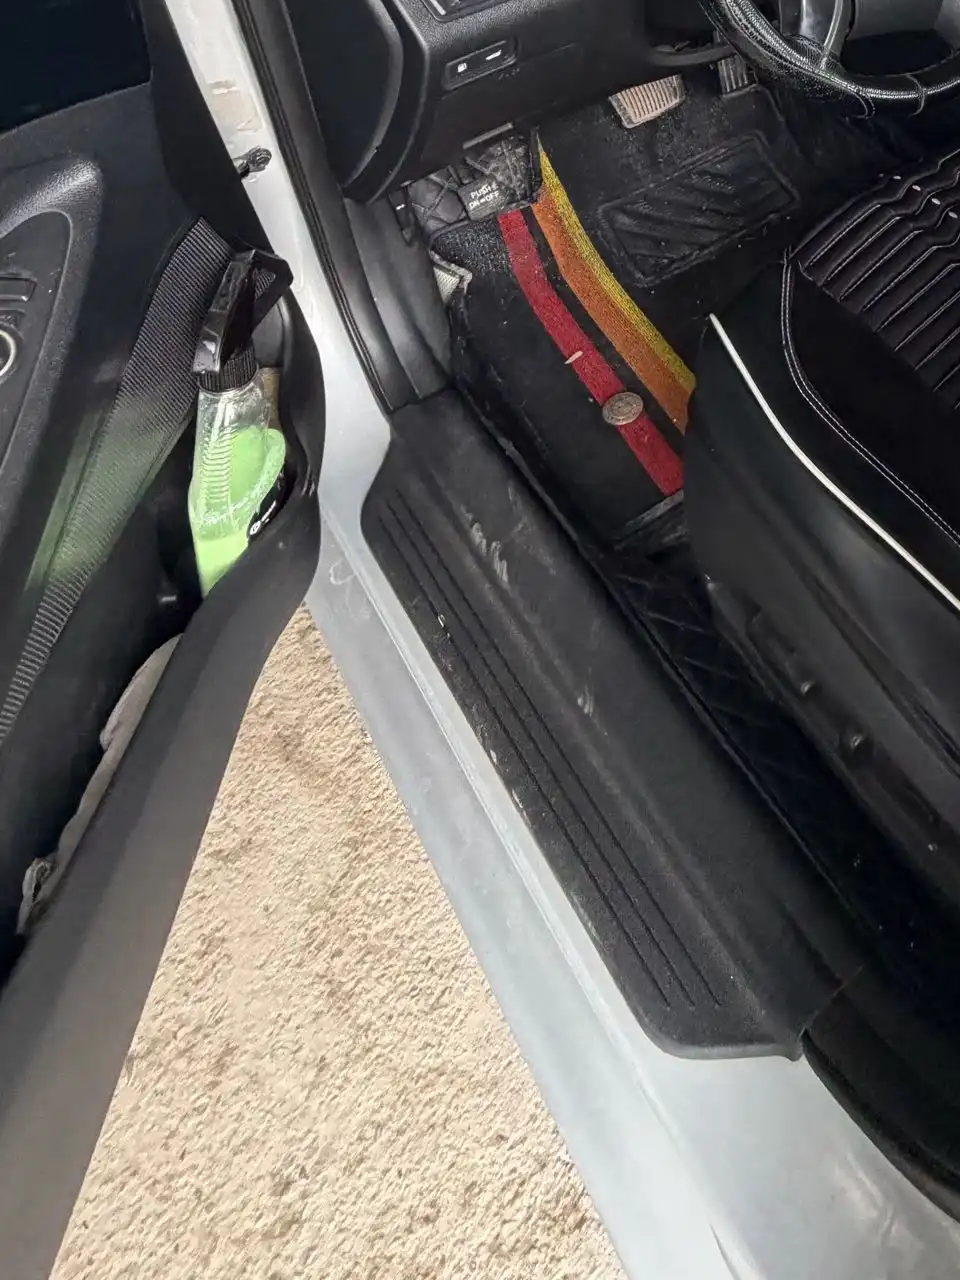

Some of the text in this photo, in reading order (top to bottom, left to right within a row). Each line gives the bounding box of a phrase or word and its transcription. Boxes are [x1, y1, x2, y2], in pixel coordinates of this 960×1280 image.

[469, 190, 499, 210] ON OFF
[470, 183, 492, 199] PUSH
